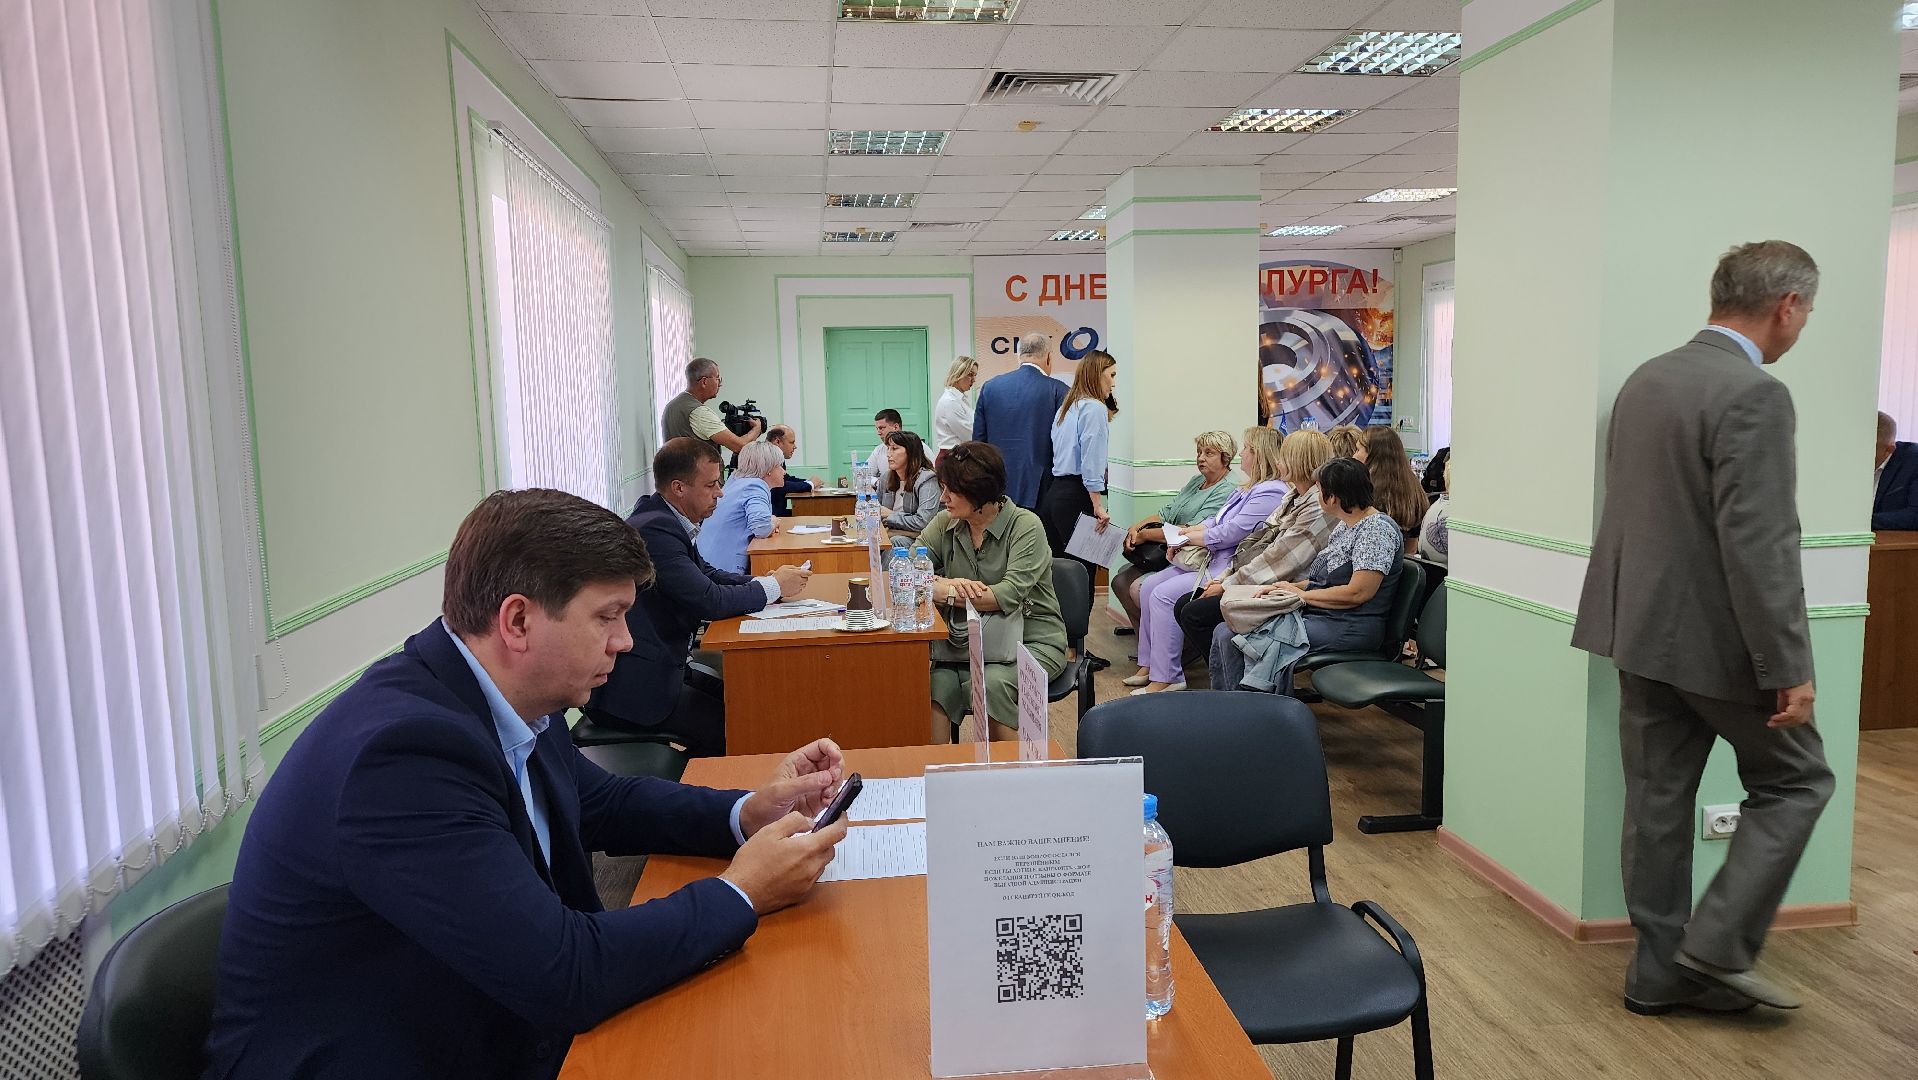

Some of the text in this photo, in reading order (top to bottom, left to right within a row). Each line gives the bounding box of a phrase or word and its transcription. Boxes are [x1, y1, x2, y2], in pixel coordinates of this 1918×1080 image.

[1006, 268, 1378, 306] С ДНЕ ЛУРГА!
[997, 839, 1027, 847] ВАЖНО
[1028, 837, 1051, 845] ВАШЕ
